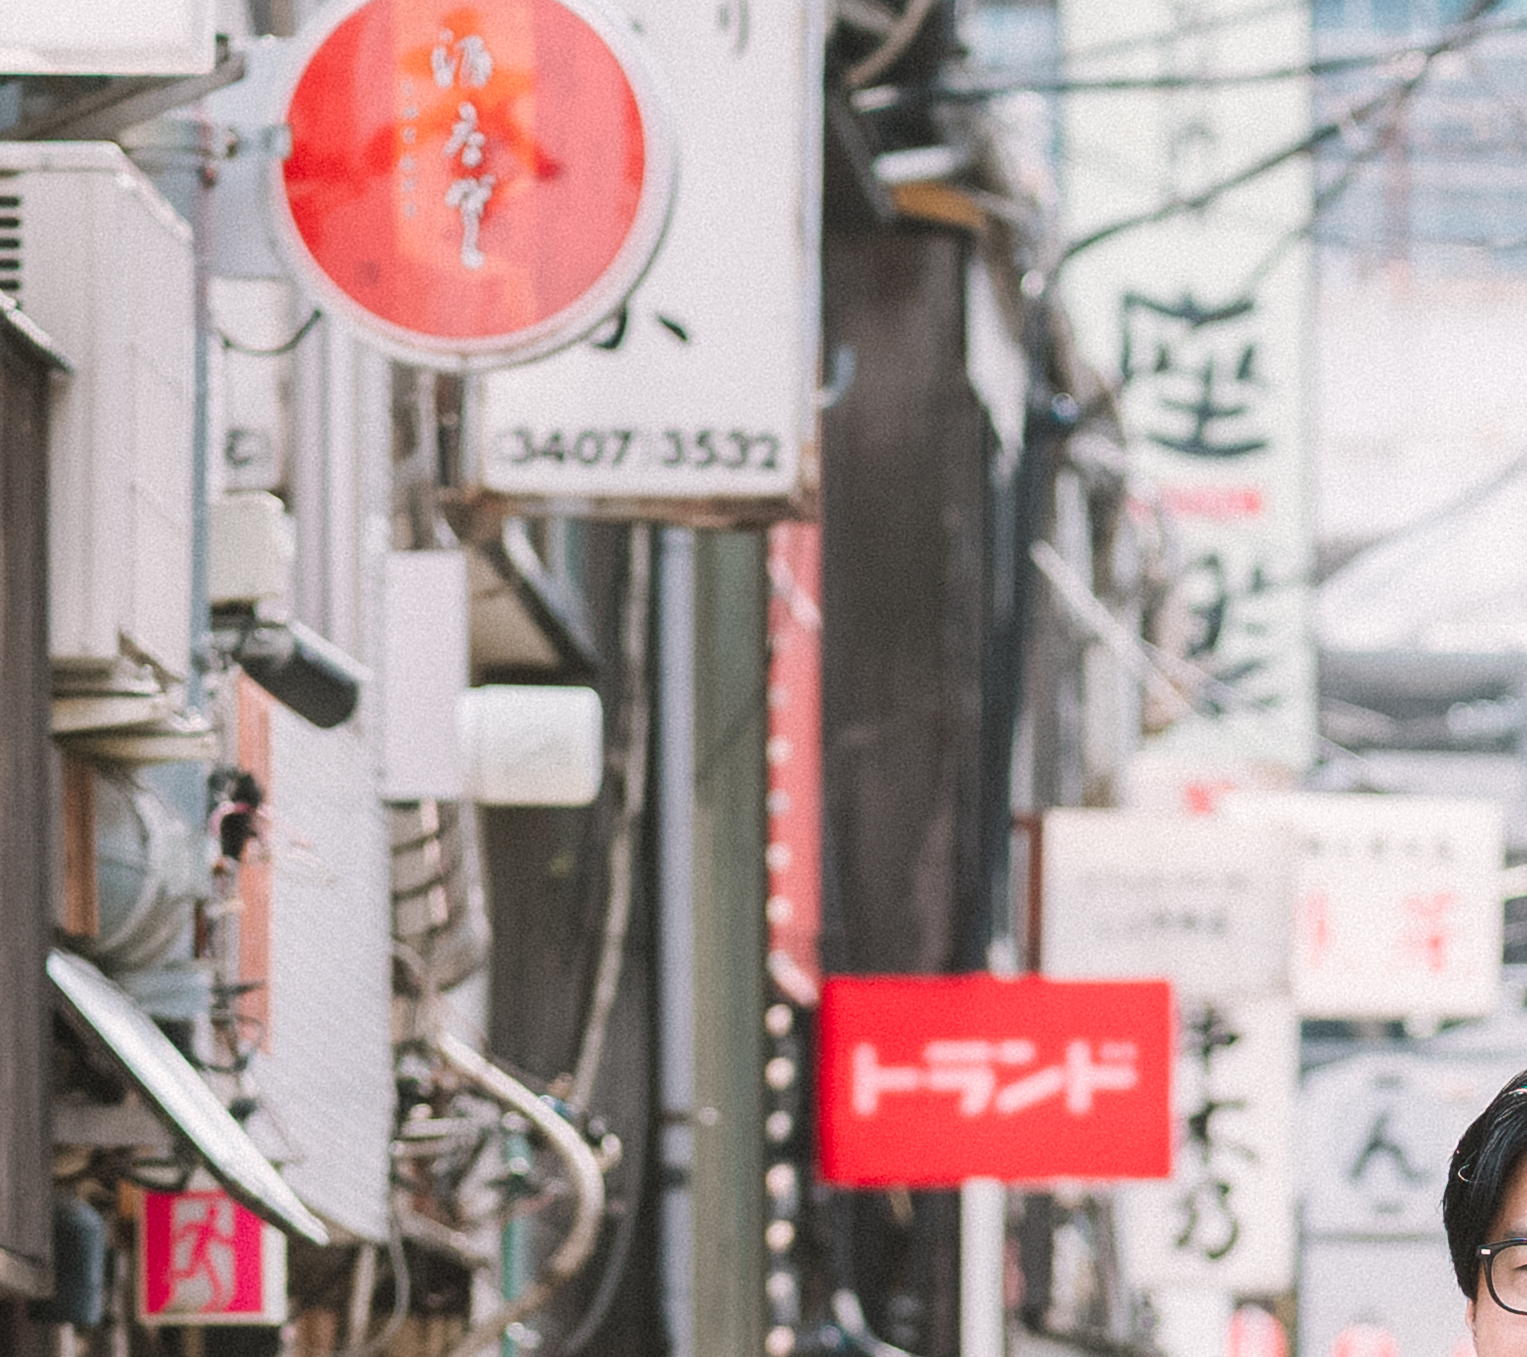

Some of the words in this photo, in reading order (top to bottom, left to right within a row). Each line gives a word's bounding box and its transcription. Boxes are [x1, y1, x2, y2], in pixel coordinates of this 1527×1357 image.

[507, 428, 634, 469] 3407
[662, 429, 780, 471] 3532
[850, 1038, 1141, 1118] トランド
